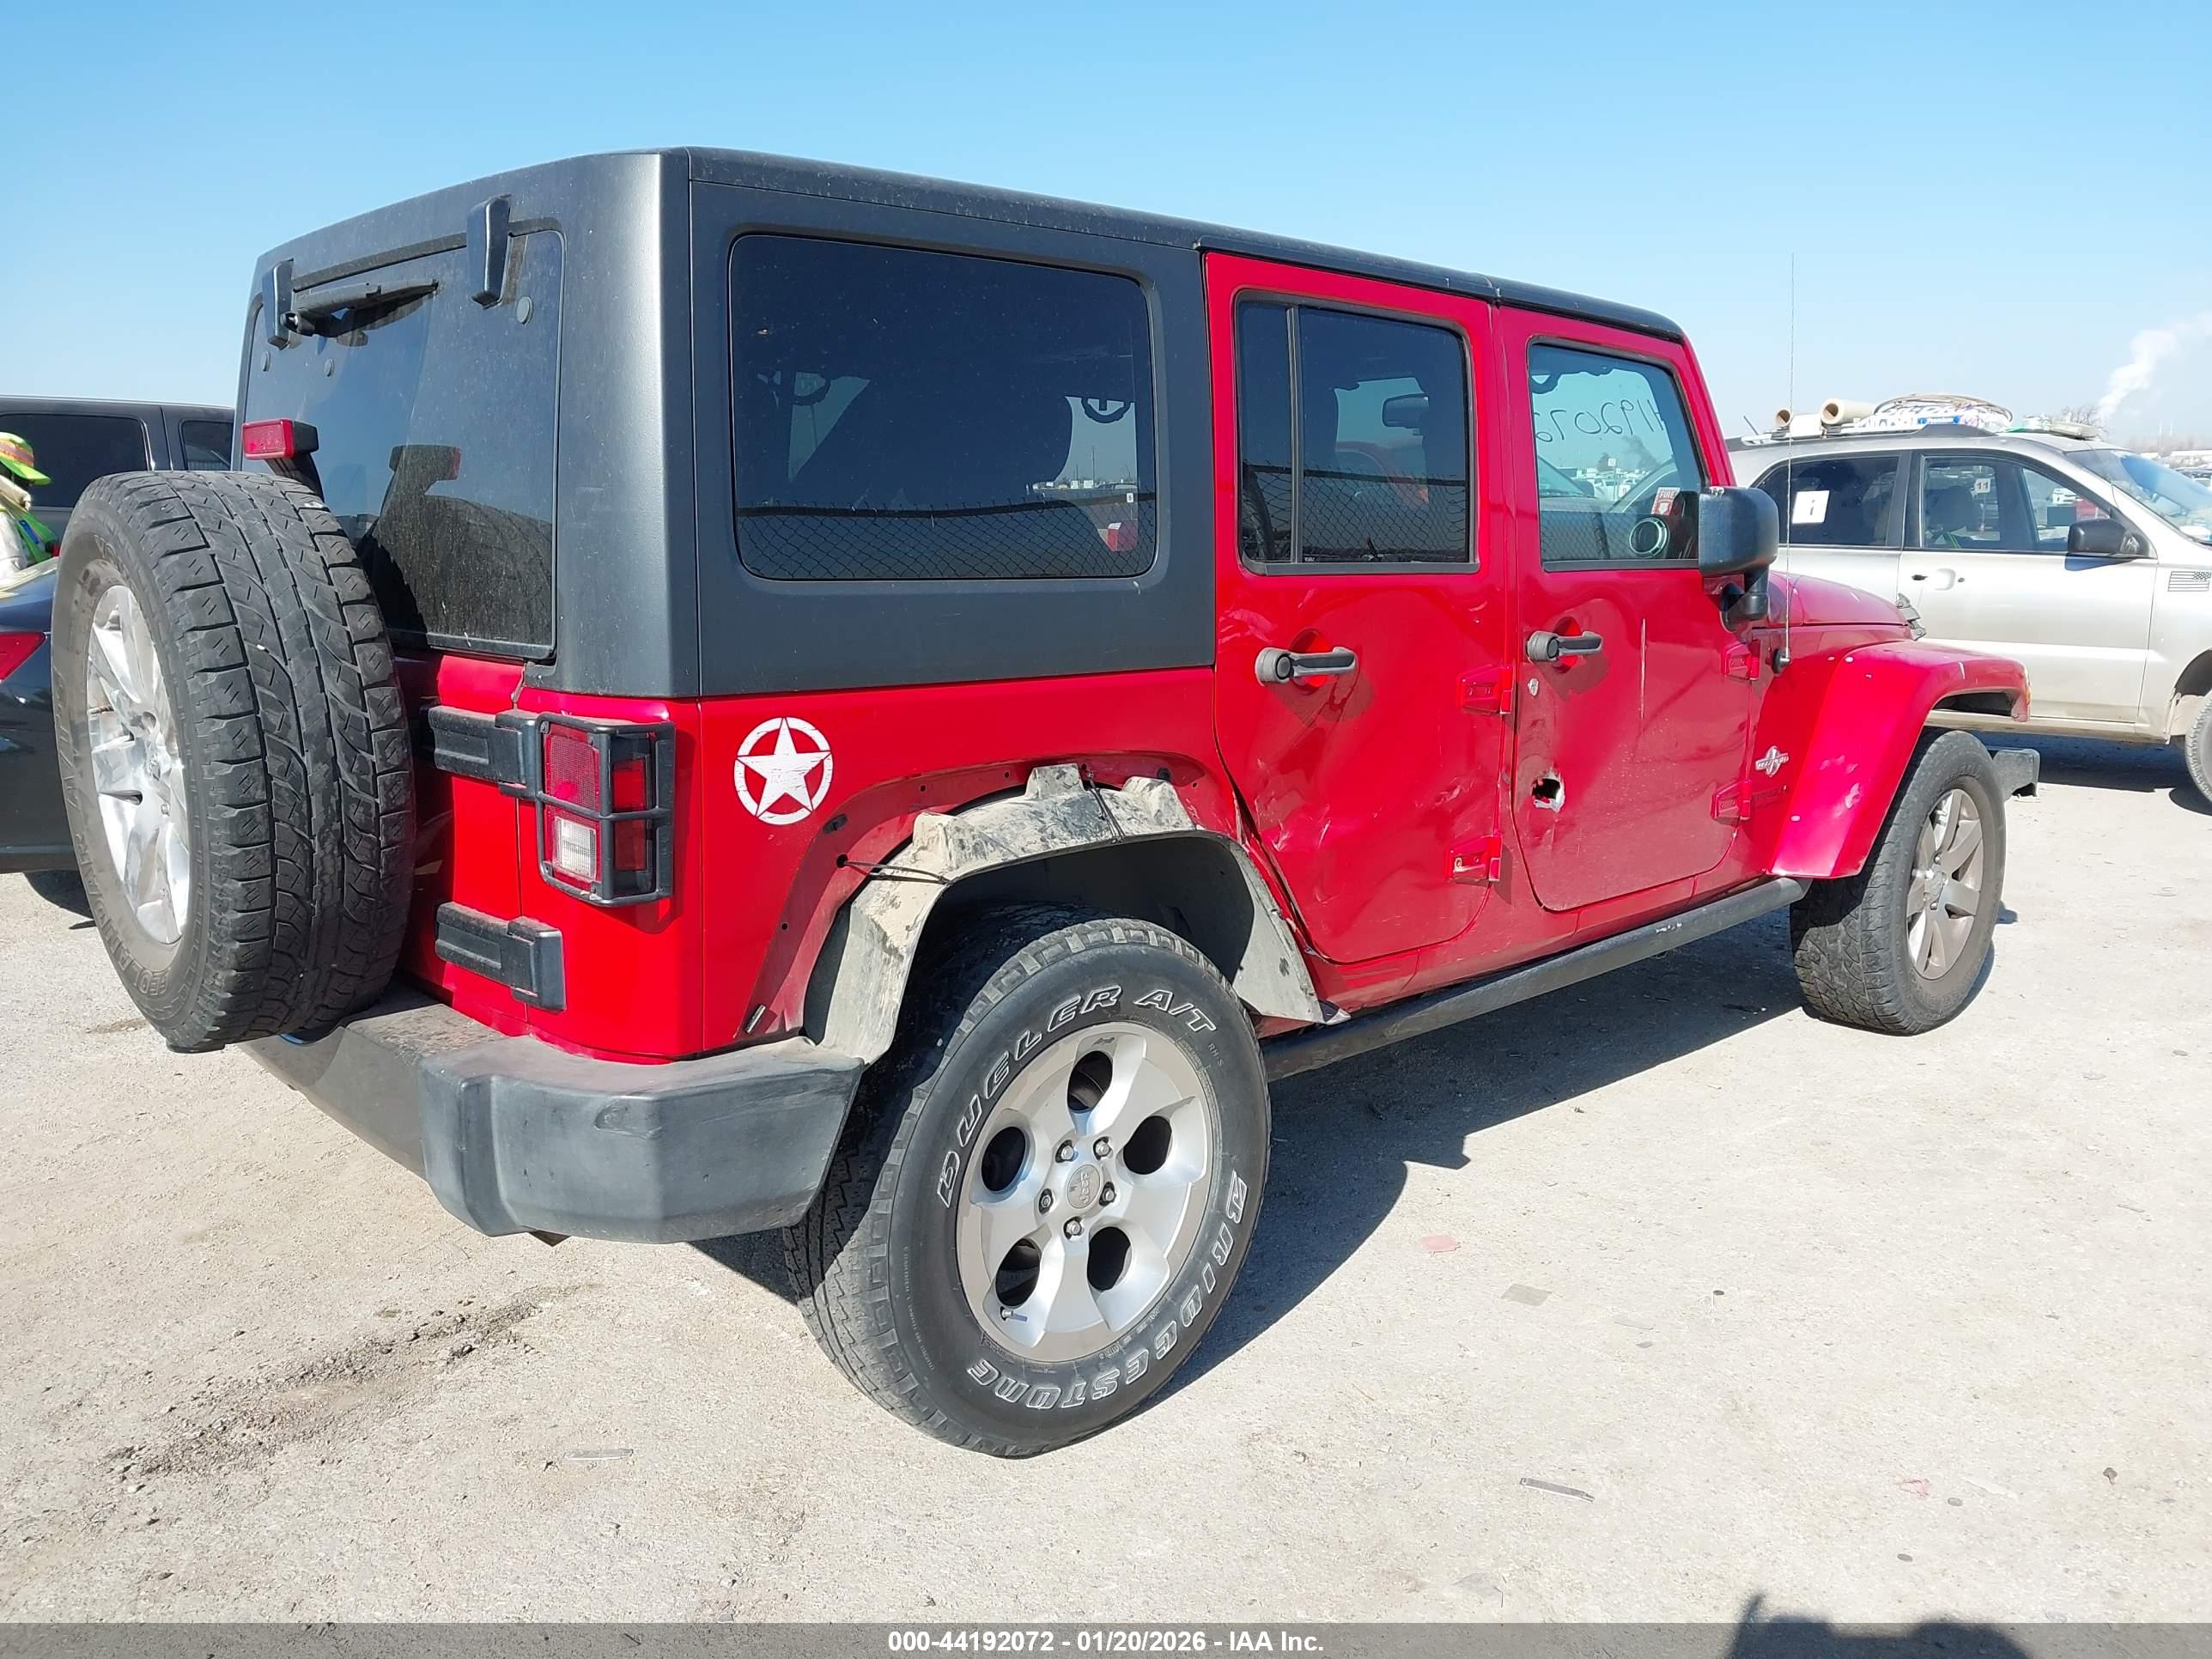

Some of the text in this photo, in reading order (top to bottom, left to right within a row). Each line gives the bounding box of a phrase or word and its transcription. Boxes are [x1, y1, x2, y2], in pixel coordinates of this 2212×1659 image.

[937, 985, 1217, 1208] DUELER A/T
[967, 1170, 1249, 1410] BRIDGESTONE
